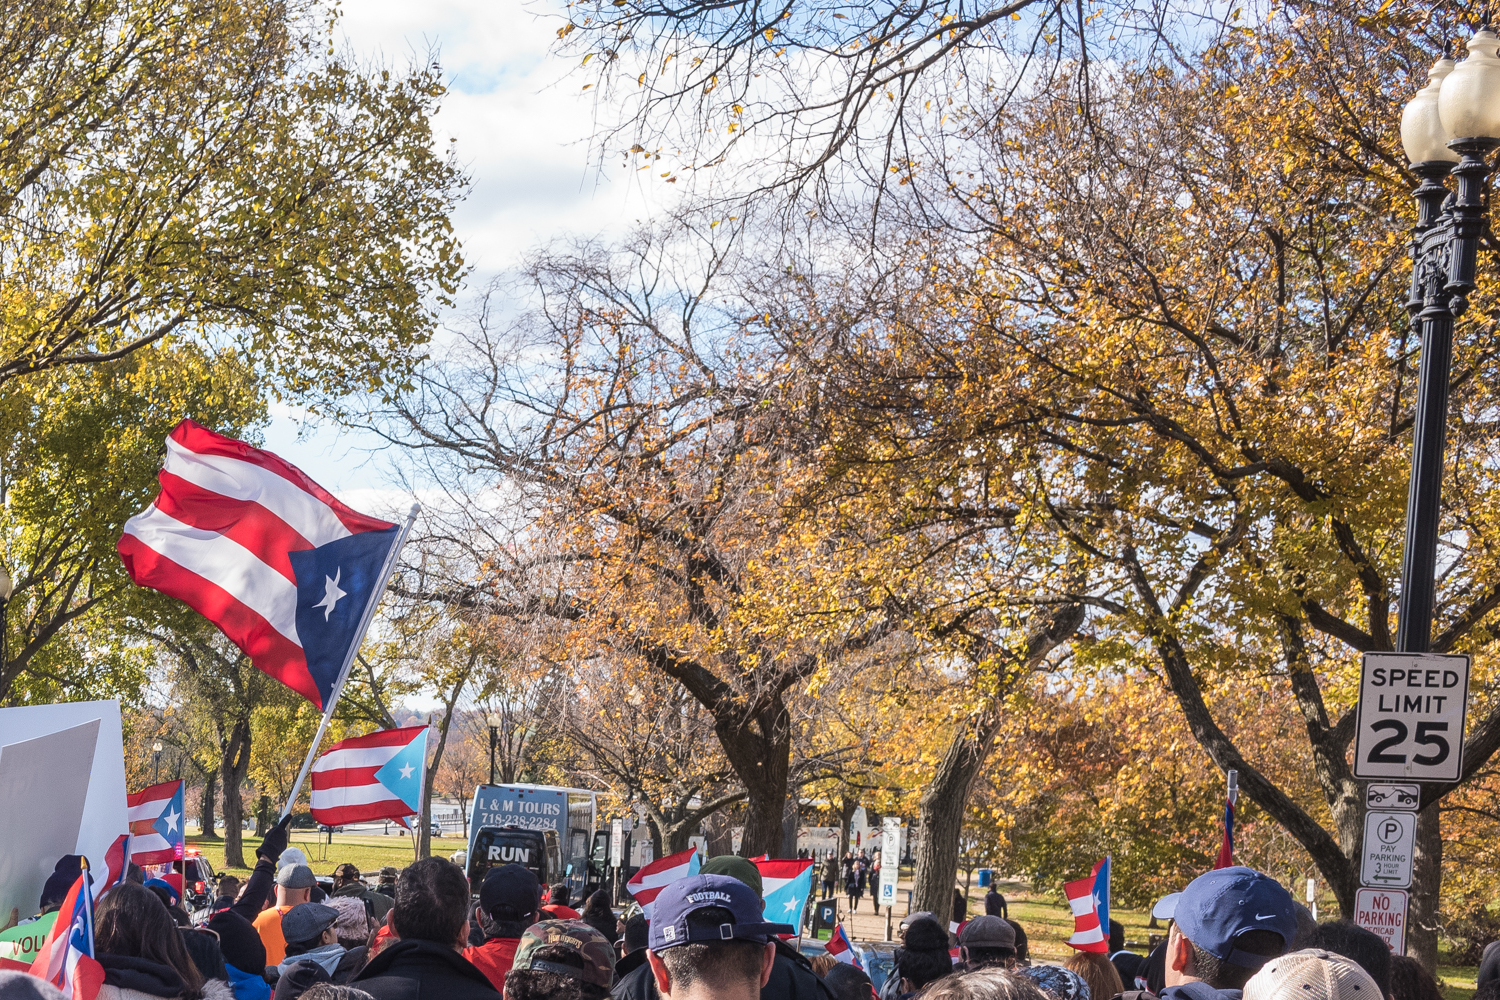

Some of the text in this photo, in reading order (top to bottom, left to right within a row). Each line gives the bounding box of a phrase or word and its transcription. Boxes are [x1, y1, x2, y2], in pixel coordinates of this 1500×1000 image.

[1370, 667, 1459, 689] SPEED
[1378, 694, 1448, 714] LIMIT
[1366, 718, 1451, 767] 25
[479, 798, 561, 816] L & M TOURS
[481, 812, 557, 829] 718-238-2284
[1384, 822, 1398, 840] P
[487, 845, 530, 863] RUN
[1380, 844, 1397, 853] PAY
[1369, 853, 1406, 863] PARKING
[1374, 862, 1382, 874] 3
[685, 891, 732, 904] FOOTBALL
[1372, 896, 1390, 911] NO
[823, 907, 833, 921] P
[1358, 910, 1402, 927] PARKING
